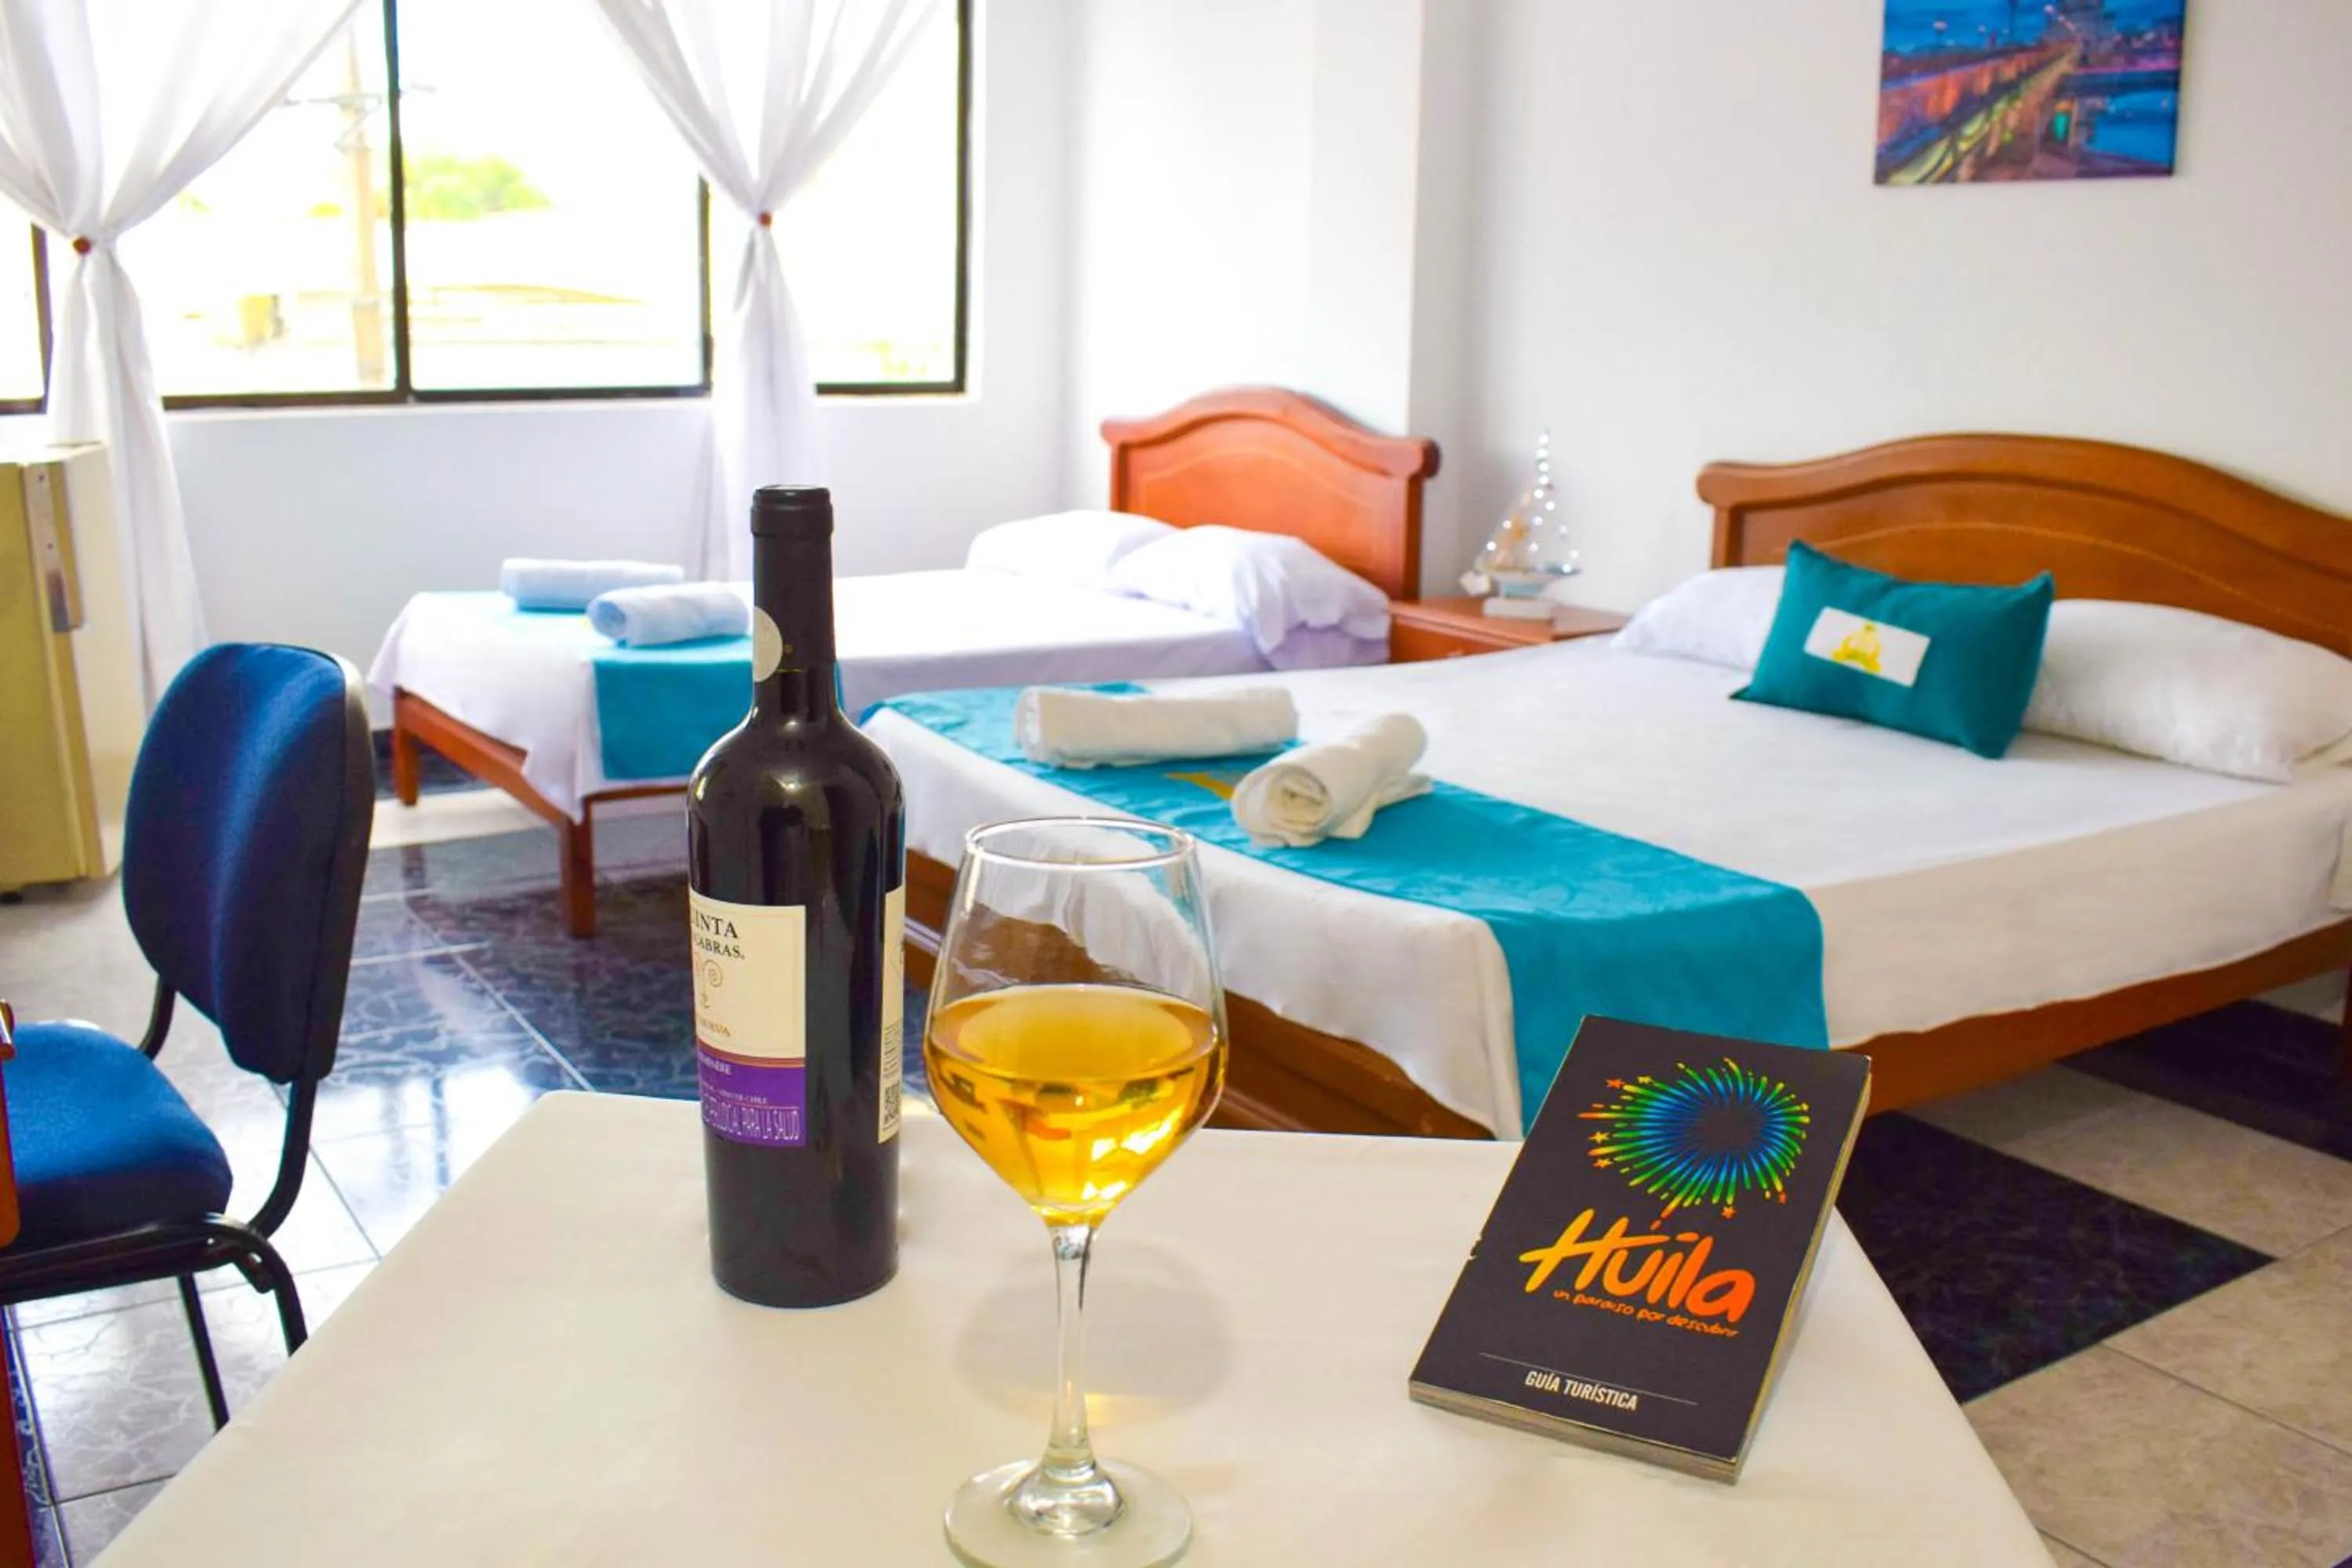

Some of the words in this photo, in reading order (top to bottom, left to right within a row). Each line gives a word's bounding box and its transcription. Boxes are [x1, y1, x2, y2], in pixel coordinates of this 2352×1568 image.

[1552, 1289, 1570, 1301] un
[1635, 1307, 1666, 1323] por
[1524, 1370, 1562, 1393] GUÍA
[1563, 1378, 1640, 1411] TURÍSTICA
